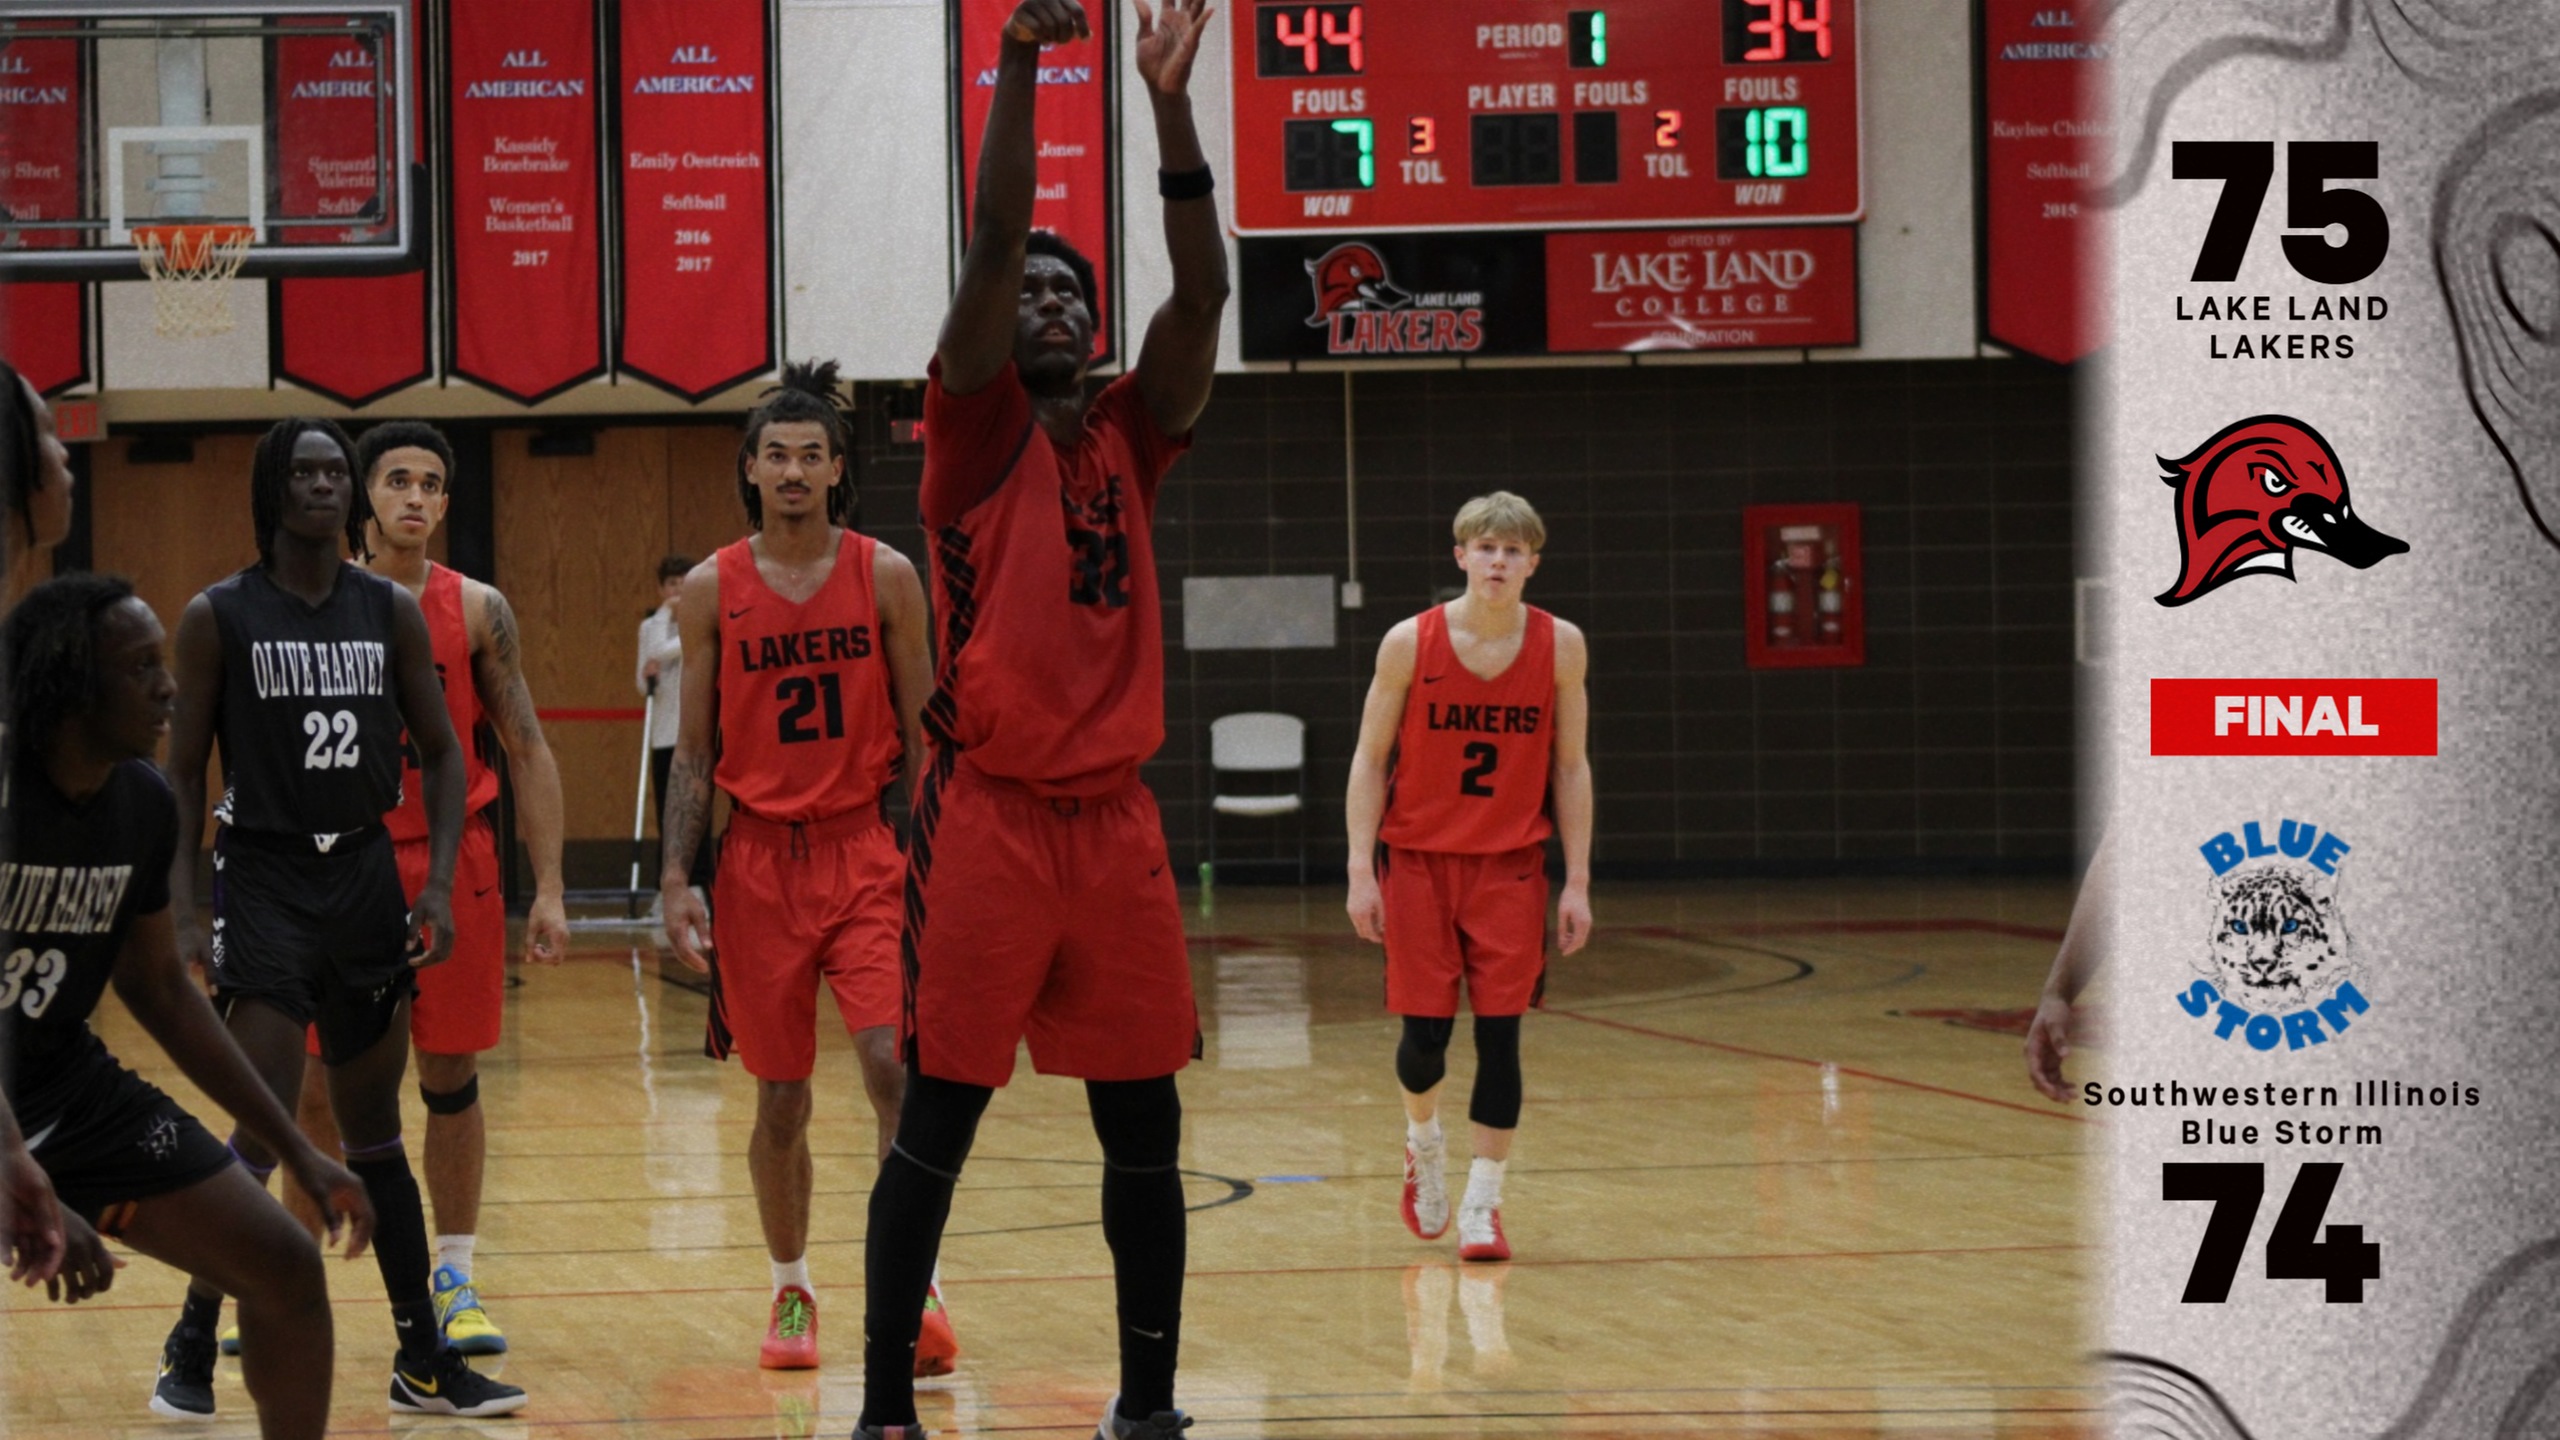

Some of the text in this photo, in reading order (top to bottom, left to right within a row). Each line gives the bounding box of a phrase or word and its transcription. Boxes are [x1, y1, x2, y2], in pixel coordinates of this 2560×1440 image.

[2031, 10, 2074, 27] ALL
[1276, 6, 1363, 73] 44
[1476, 10, 1606, 67] PERIOD 1
[1744, 0, 1832, 61] 34
[329, 51, 375, 68] ALL
[502, 50, 547, 68] ALL
[671, 46, 717, 64] ALL
[465, 80, 584, 98] AMERICAN
[634, 75, 754, 95] AMERICAN
[1468, 80, 1648, 109] PLAYER FOULS
[1724, 77, 1799, 102] FOULS
[1292, 88, 1365, 114] FOULS
[1411, 117, 1435, 154] 3
[1656, 110, 1682, 148] 2
[1992, 121, 2048, 139] Kaylee
[494, 137, 558, 157] Kassidy
[1038, 141, 1085, 158] Jones
[1745, 106, 1809, 178] 10
[630, 152, 760, 171] Emily Oestreich
[1331, 119, 1375, 188] 7
[15, 161, 61, 179] Short
[483, 156, 570, 173] Bonebrake
[1400, 160, 1445, 185] TOL
[1644, 153, 1690, 178] TOL
[2026, 163, 2090, 179] Softball
[489, 197, 564, 214] Women's
[662, 194, 727, 211] Softball
[1735, 184, 1786, 206] WON
[1303, 196, 1353, 217] WON
[2042, 203, 2079, 218] 2015
[485, 215, 574, 233] Basketball
[674, 230, 711, 246] 2016
[1668, 234, 1734, 248] GIFTED BY
[512, 250, 549, 267] 2017
[676, 256, 713, 273] 2017
[1591, 250, 1815, 293] LAKE LAND
[1415, 292, 1481, 308] LAKE LAND
[1615, 294, 1789, 317] COLLEGE
[1326, 308, 1483, 354] LAKERS
[738, 626, 872, 673] LAKERS
[252, 641, 314, 700] OLIVE
[314, 641, 385, 697] HARVEY
[775, 672, 845, 745] 21
[1428, 703, 1541, 735] LAKERS
[303, 710, 360, 770] 22
[1460, 741, 1498, 798] 2
[0, 947, 68, 1019] 33
